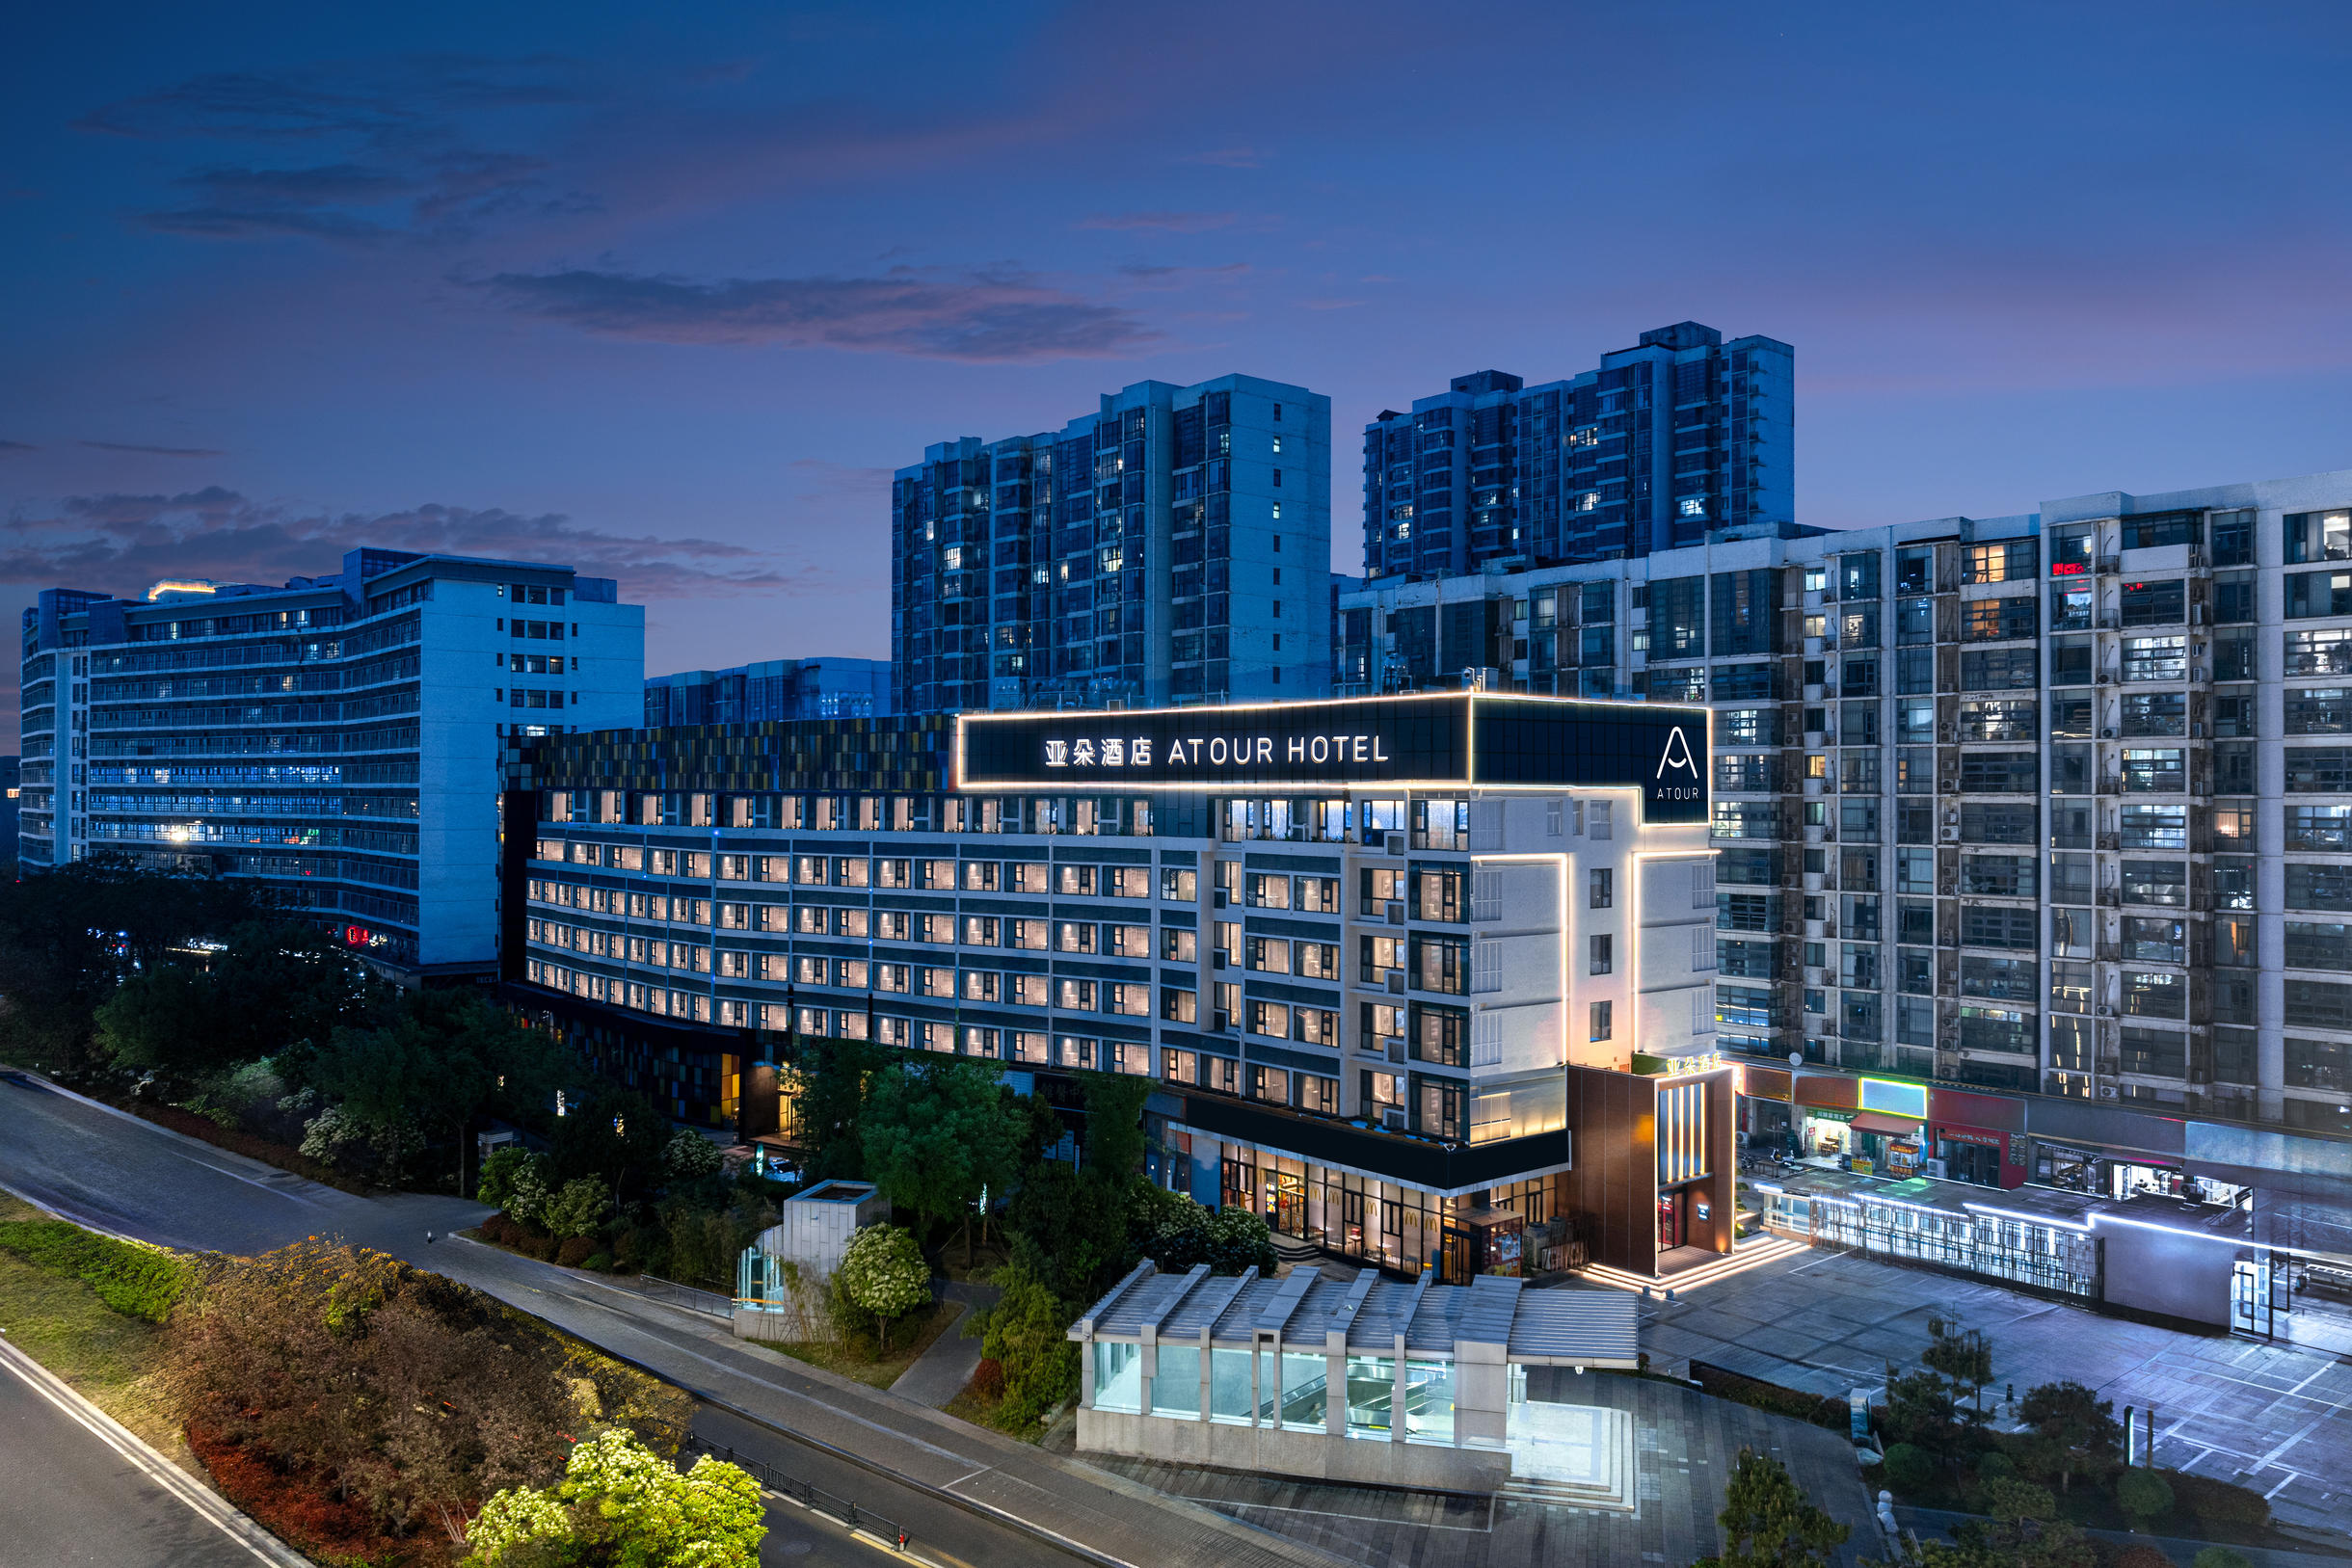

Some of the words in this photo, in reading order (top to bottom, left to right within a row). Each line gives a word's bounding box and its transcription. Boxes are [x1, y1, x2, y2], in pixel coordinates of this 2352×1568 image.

[1045, 736, 1153, 767] 亚朵酒店
[1167, 736, 1273, 766] ATOUR
[1288, 735, 1389, 764] HOTEL
[1656, 786, 1699, 801] ATOUR
[1666, 1050, 1722, 1078] 亚朵酒店
